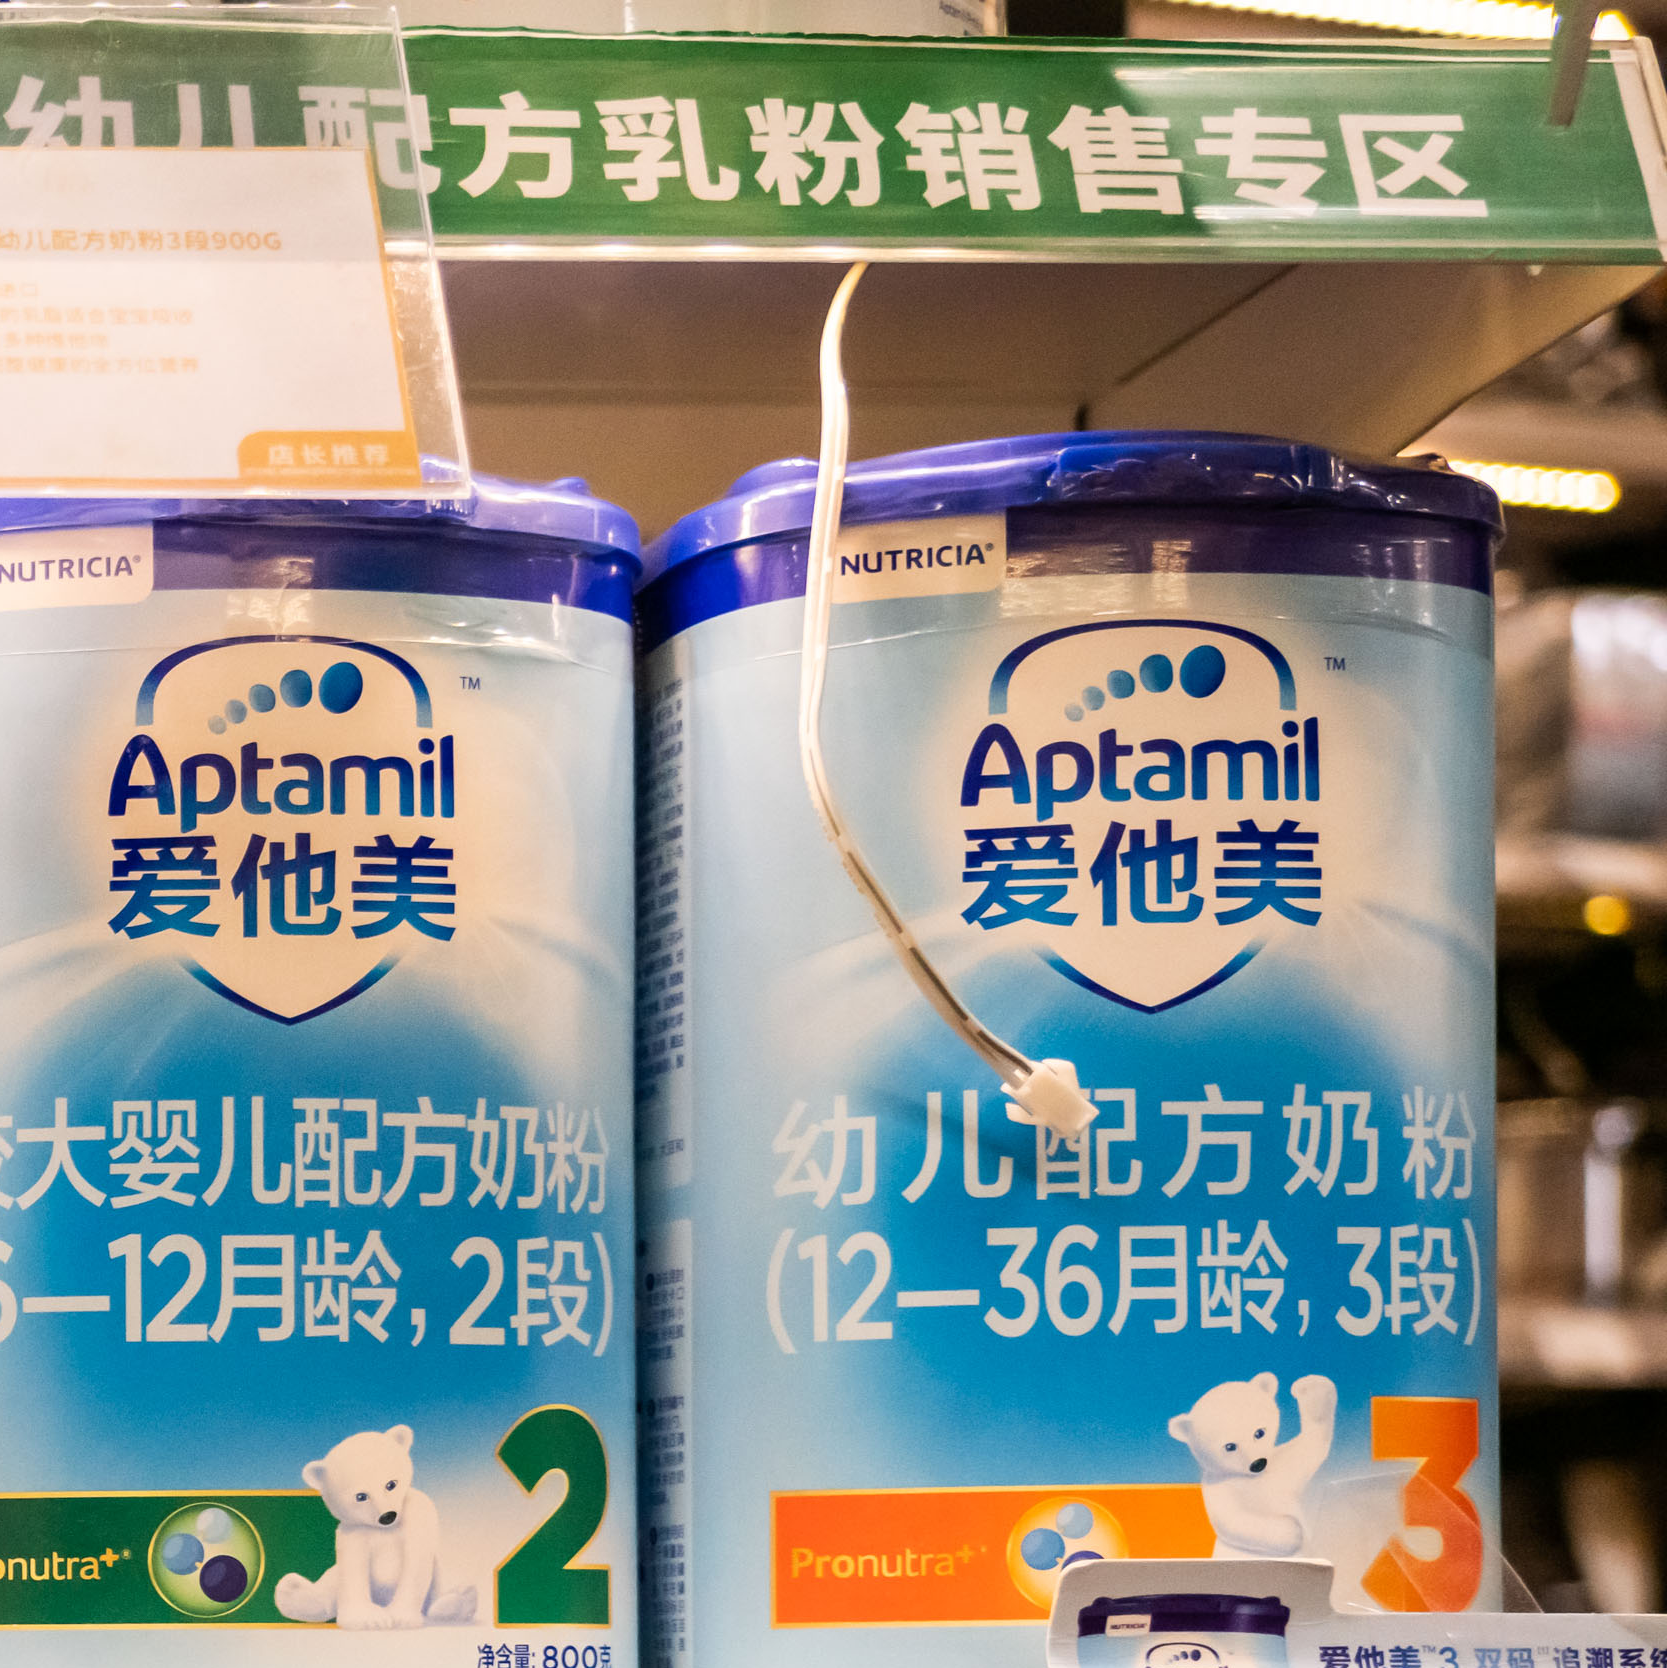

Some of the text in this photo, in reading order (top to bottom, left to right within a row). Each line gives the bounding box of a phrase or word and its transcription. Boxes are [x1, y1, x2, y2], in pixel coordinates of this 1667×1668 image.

[107, 734, 456, 834] Aptamil
[959, 715, 1321, 823] Aptamil
[107, 832, 457, 943] 爱他美
[959, 819, 1324, 932] 爱他美
[771, 1082, 1476, 1211] 幼儿配方奶粉
[492, 1402, 613, 1629] 2
[1360, 1395, 1484, 1612] 3
